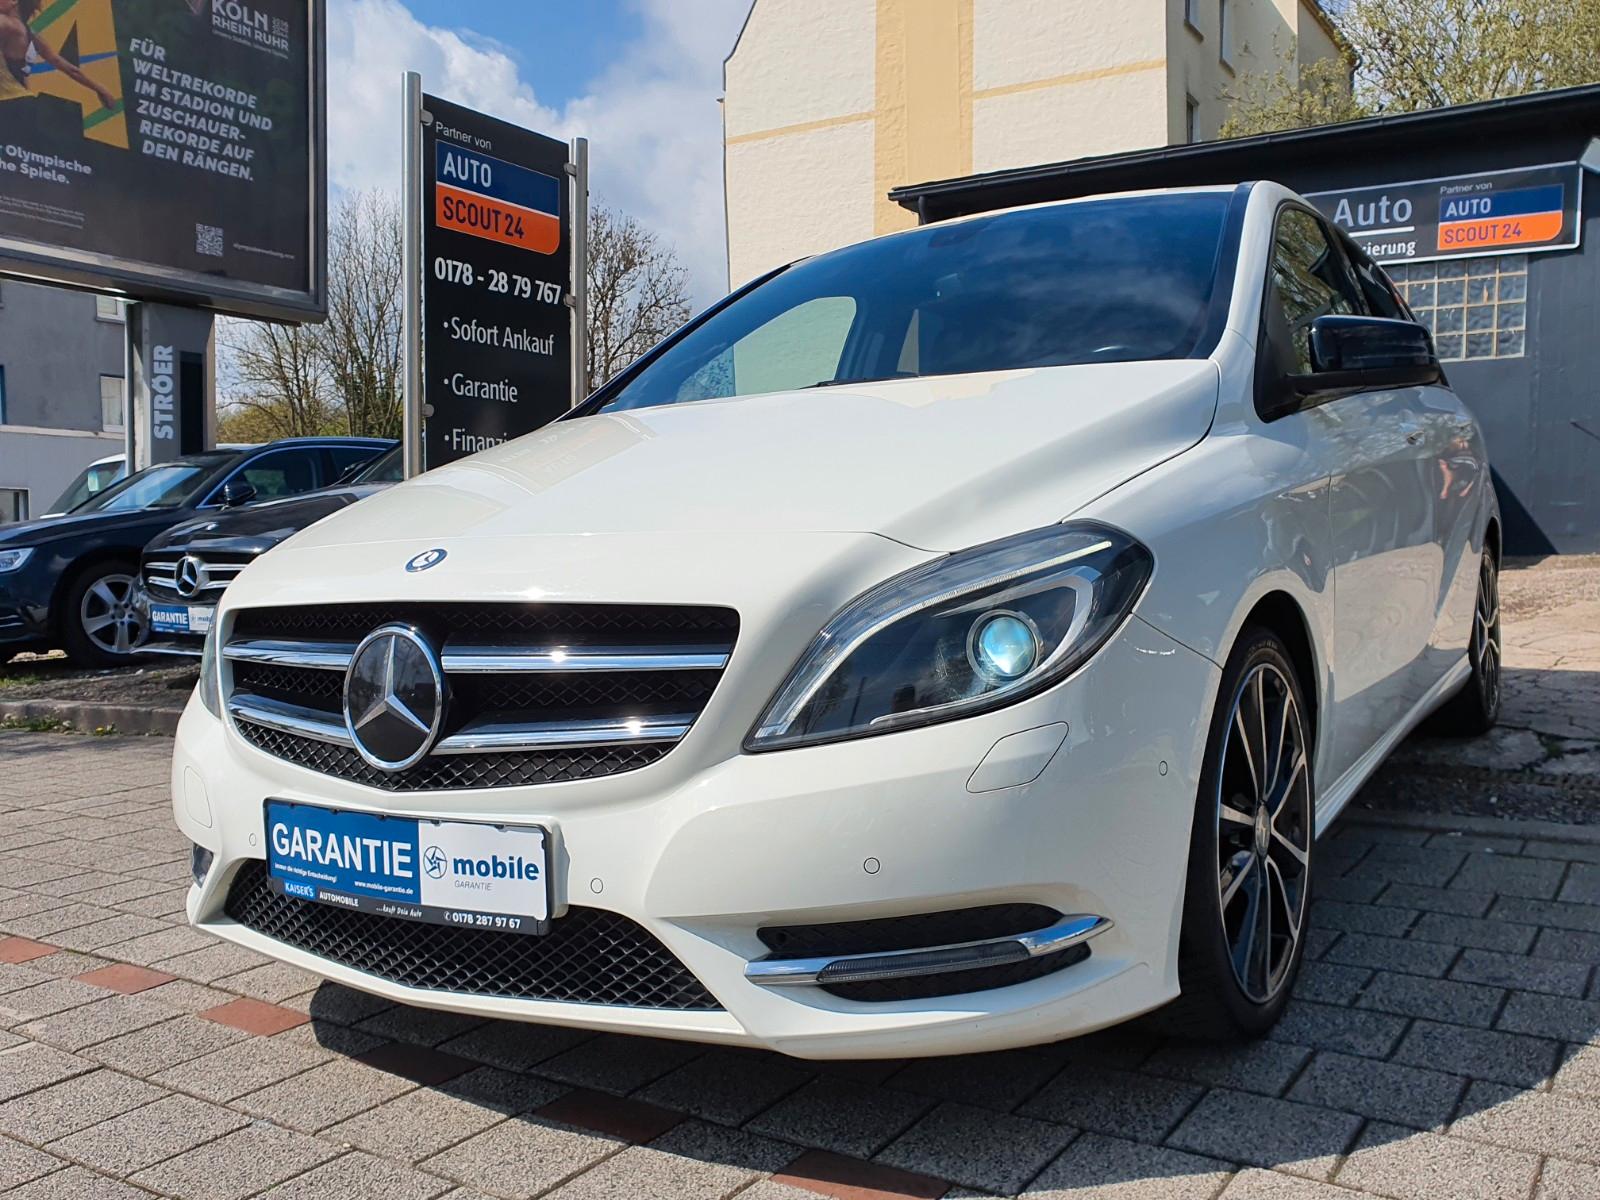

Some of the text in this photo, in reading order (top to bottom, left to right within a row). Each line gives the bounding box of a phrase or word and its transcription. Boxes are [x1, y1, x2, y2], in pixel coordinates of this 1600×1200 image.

[212, 14, 251, 38] RHEIN
[254, 30, 288, 51] RUHR
[129, 38, 166, 61] FÜR
[132, 57, 257, 109] WELTREKORDE
[134, 79, 273, 131] IM STADION UND
[136, 99, 246, 140] ZUSCHAUER-
[139, 119, 255, 163] REKORDE AUF
[435, 121, 492, 150] Partner von
[5, 144, 92, 174] Olympische
[20, 162, 70, 184] Spiele.
[142, 140, 254, 181] DEN RÄNGEN.
[443, 152, 492, 188] AUTO
[1440, 182, 1493, 195] Partner von
[1333, 195, 1413, 227] Auto
[1445, 197, 1492, 218] AUTO
[1362, 241, 1418, 256] ierung
[434, 257, 473, 286] 0178
[488, 269, 509, 294] 28
[512, 275, 531, 298] 79
[535, 280, 562, 305] 767
[451, 316, 554, 356] Sofort Ankauf
[151, 345, 174, 440] STRÖER
[451, 373, 518, 403] Garantie
[152, 610, 189, 625] GARANTIE
[272, 822, 413, 879] GARANTIE
[453, 855, 539, 881] mobile
[319, 891, 359, 907] AUTOMOBILE
[454, 879, 493, 891] GARANTIE
[452, 912, 521, 929] 0178 287 97 67
